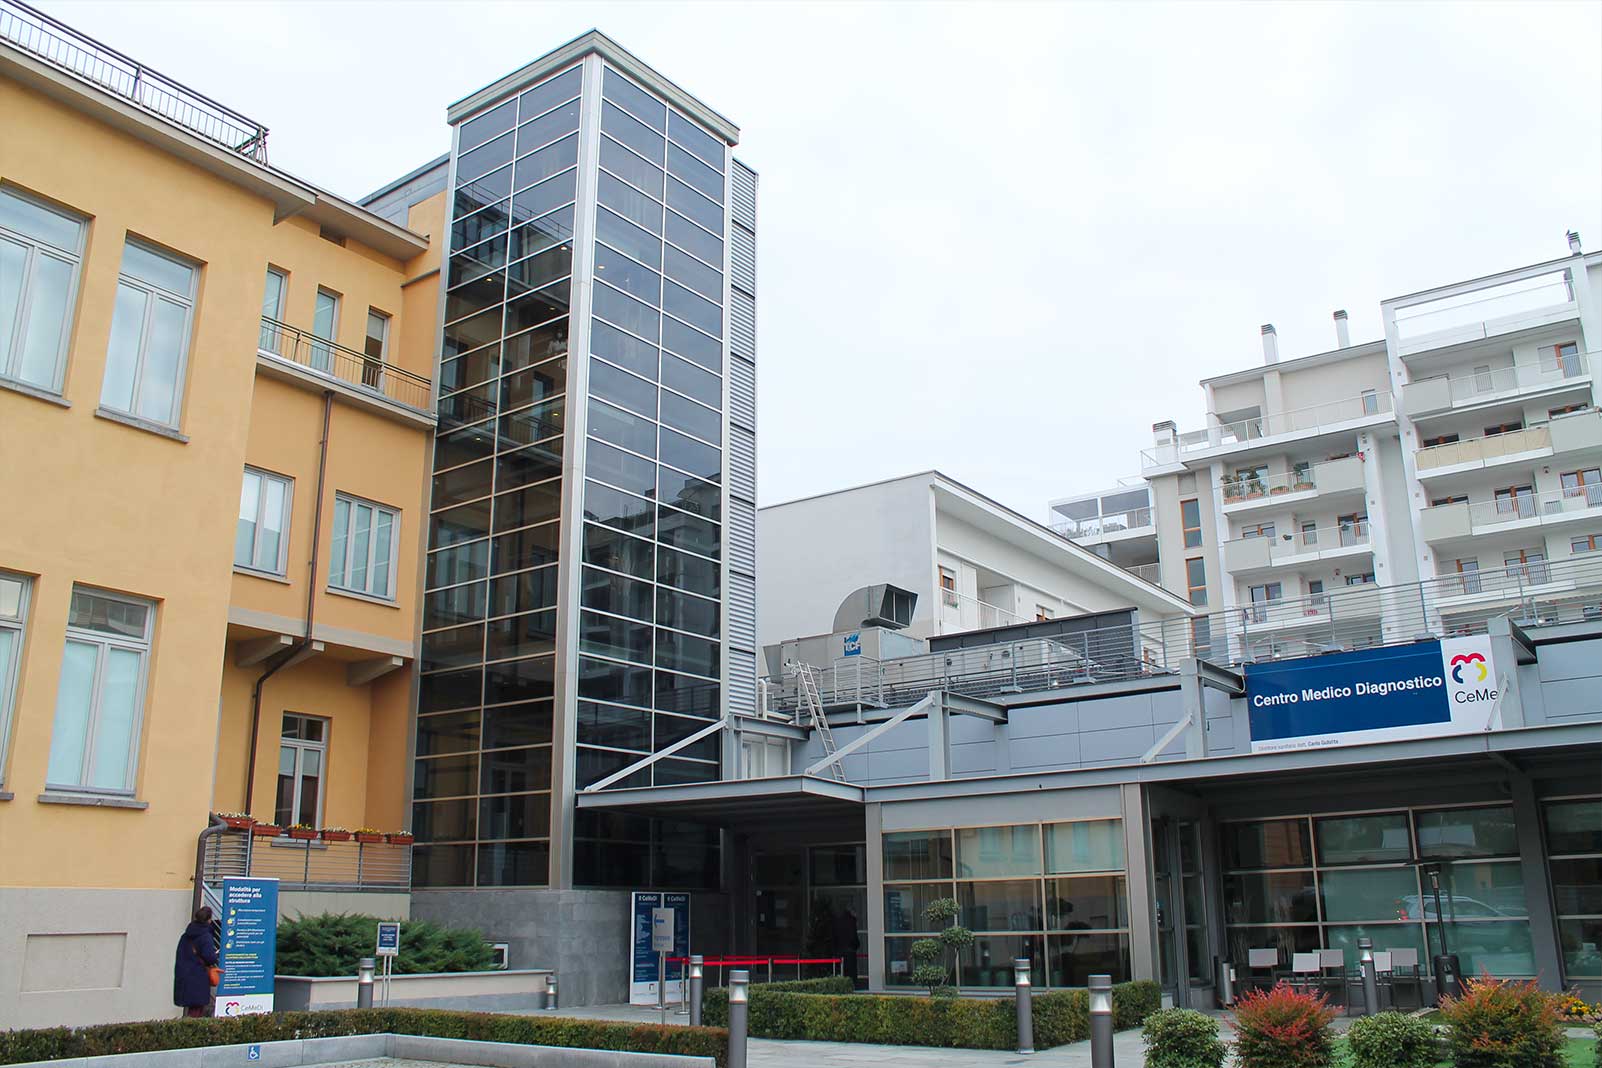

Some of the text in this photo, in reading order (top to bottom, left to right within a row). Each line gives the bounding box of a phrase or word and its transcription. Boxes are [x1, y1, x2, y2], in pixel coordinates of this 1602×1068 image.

[1254, 676, 1442, 706] Centro Medico Diagnostico
[1454, 688, 1499, 704] CeMe
